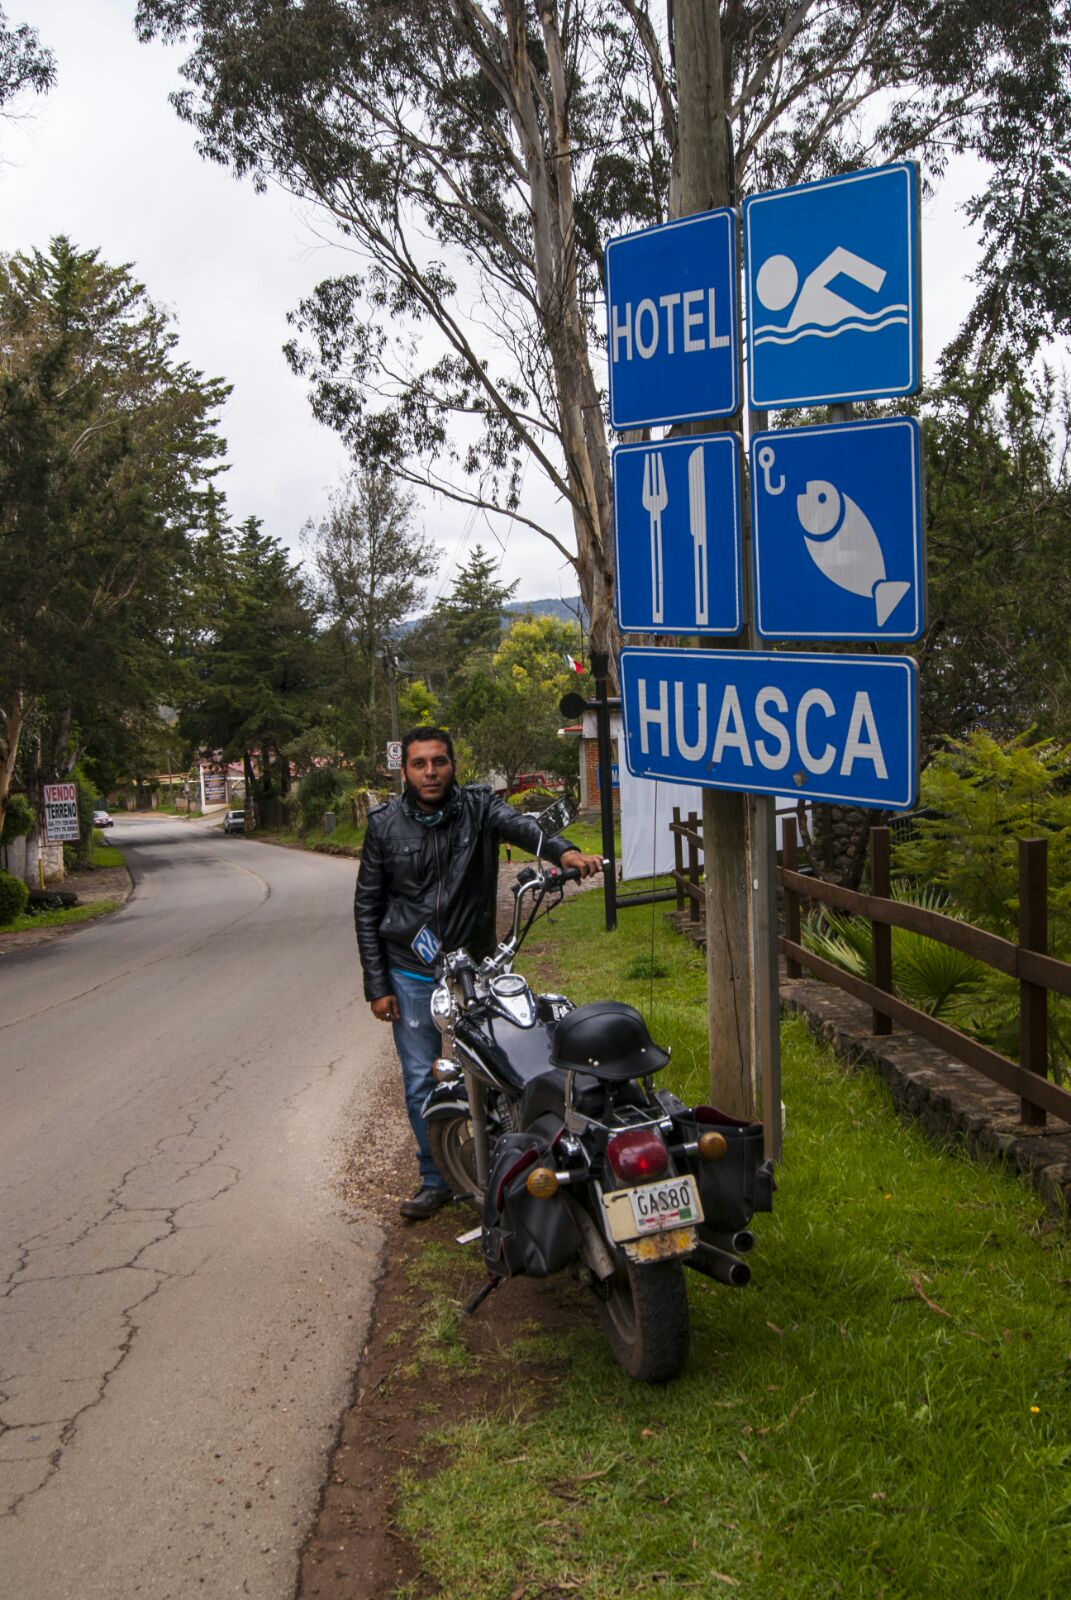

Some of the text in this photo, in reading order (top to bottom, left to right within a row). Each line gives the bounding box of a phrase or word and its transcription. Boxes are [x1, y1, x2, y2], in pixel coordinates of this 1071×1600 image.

[611, 287, 730, 363] HOTEL
[638, 678, 888, 779] HUASCA
[46, 786, 75, 801] VENDO
[47, 803, 77, 819] TERRENO
